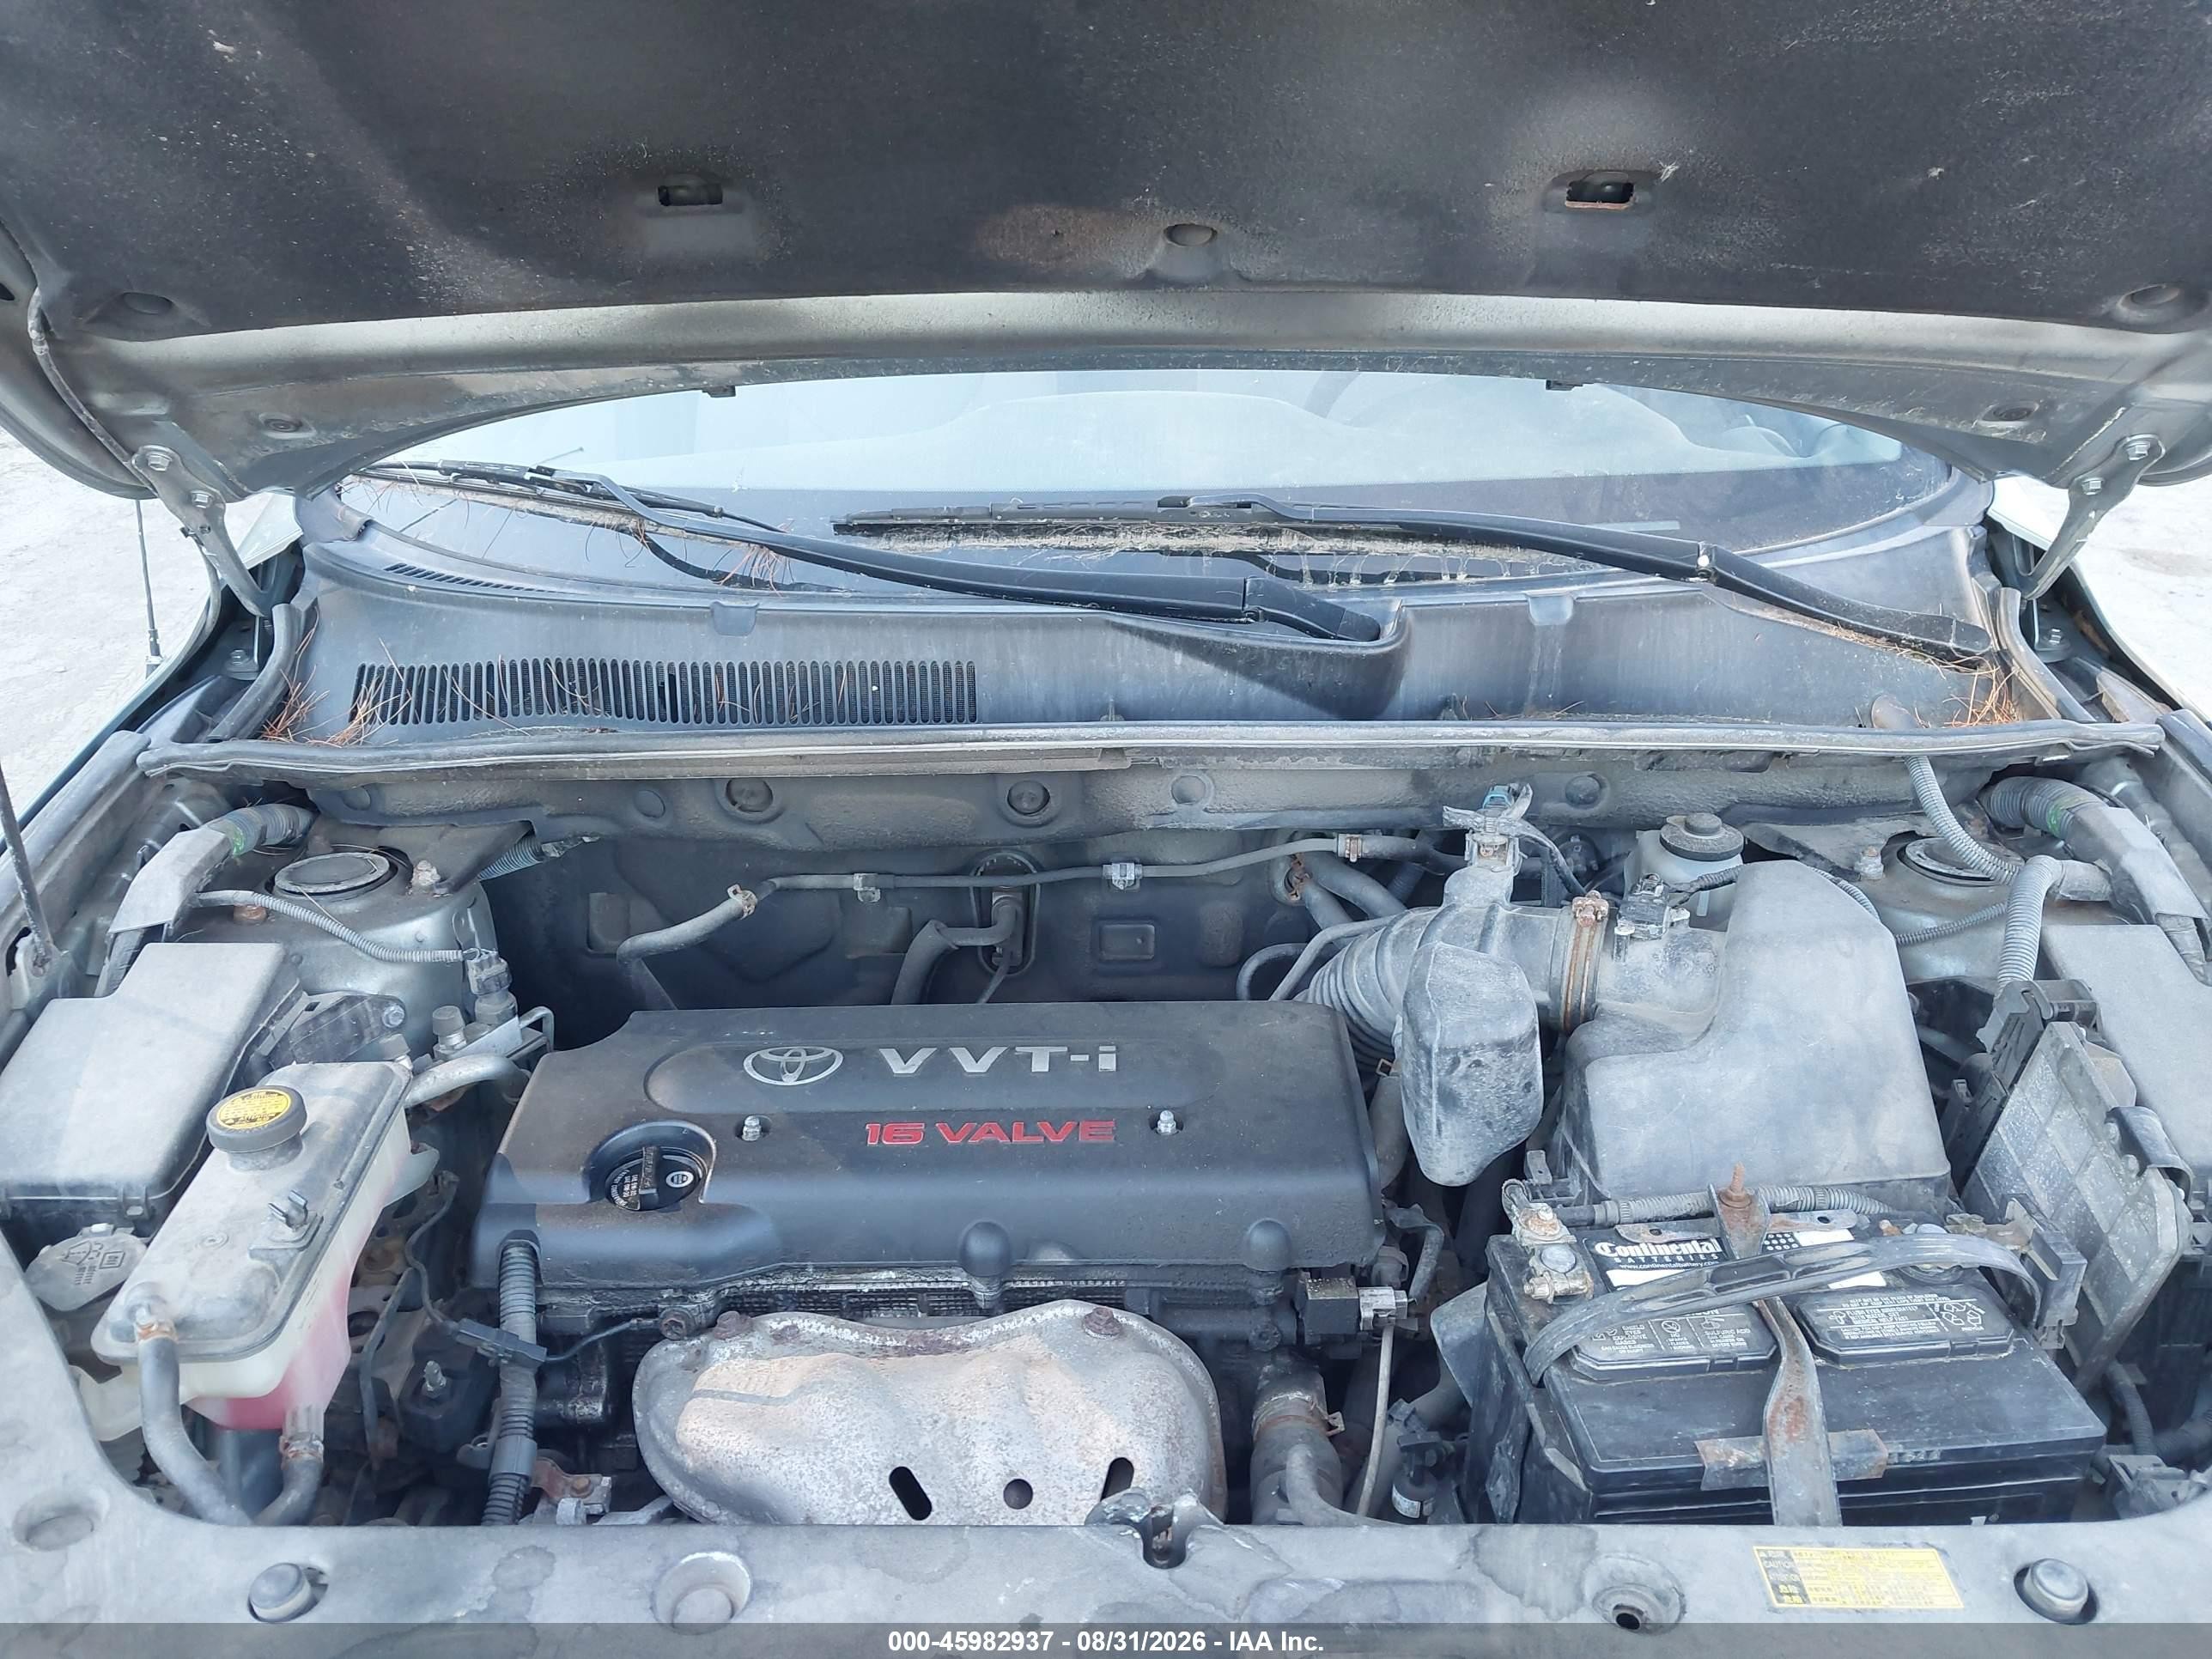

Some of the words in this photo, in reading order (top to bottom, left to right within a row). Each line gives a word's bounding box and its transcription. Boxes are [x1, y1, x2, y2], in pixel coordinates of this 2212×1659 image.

[879, 1046, 1116, 1073] VVT-i
[866, 1122, 925, 1145] 16
[935, 1121, 1115, 1143] VALVE
[1595, 1237, 1723, 1257] Continental
[1613, 1254, 1718, 1263] BATTERIES
[1620, 1261, 1720, 1269] www.continentalbattery.com
